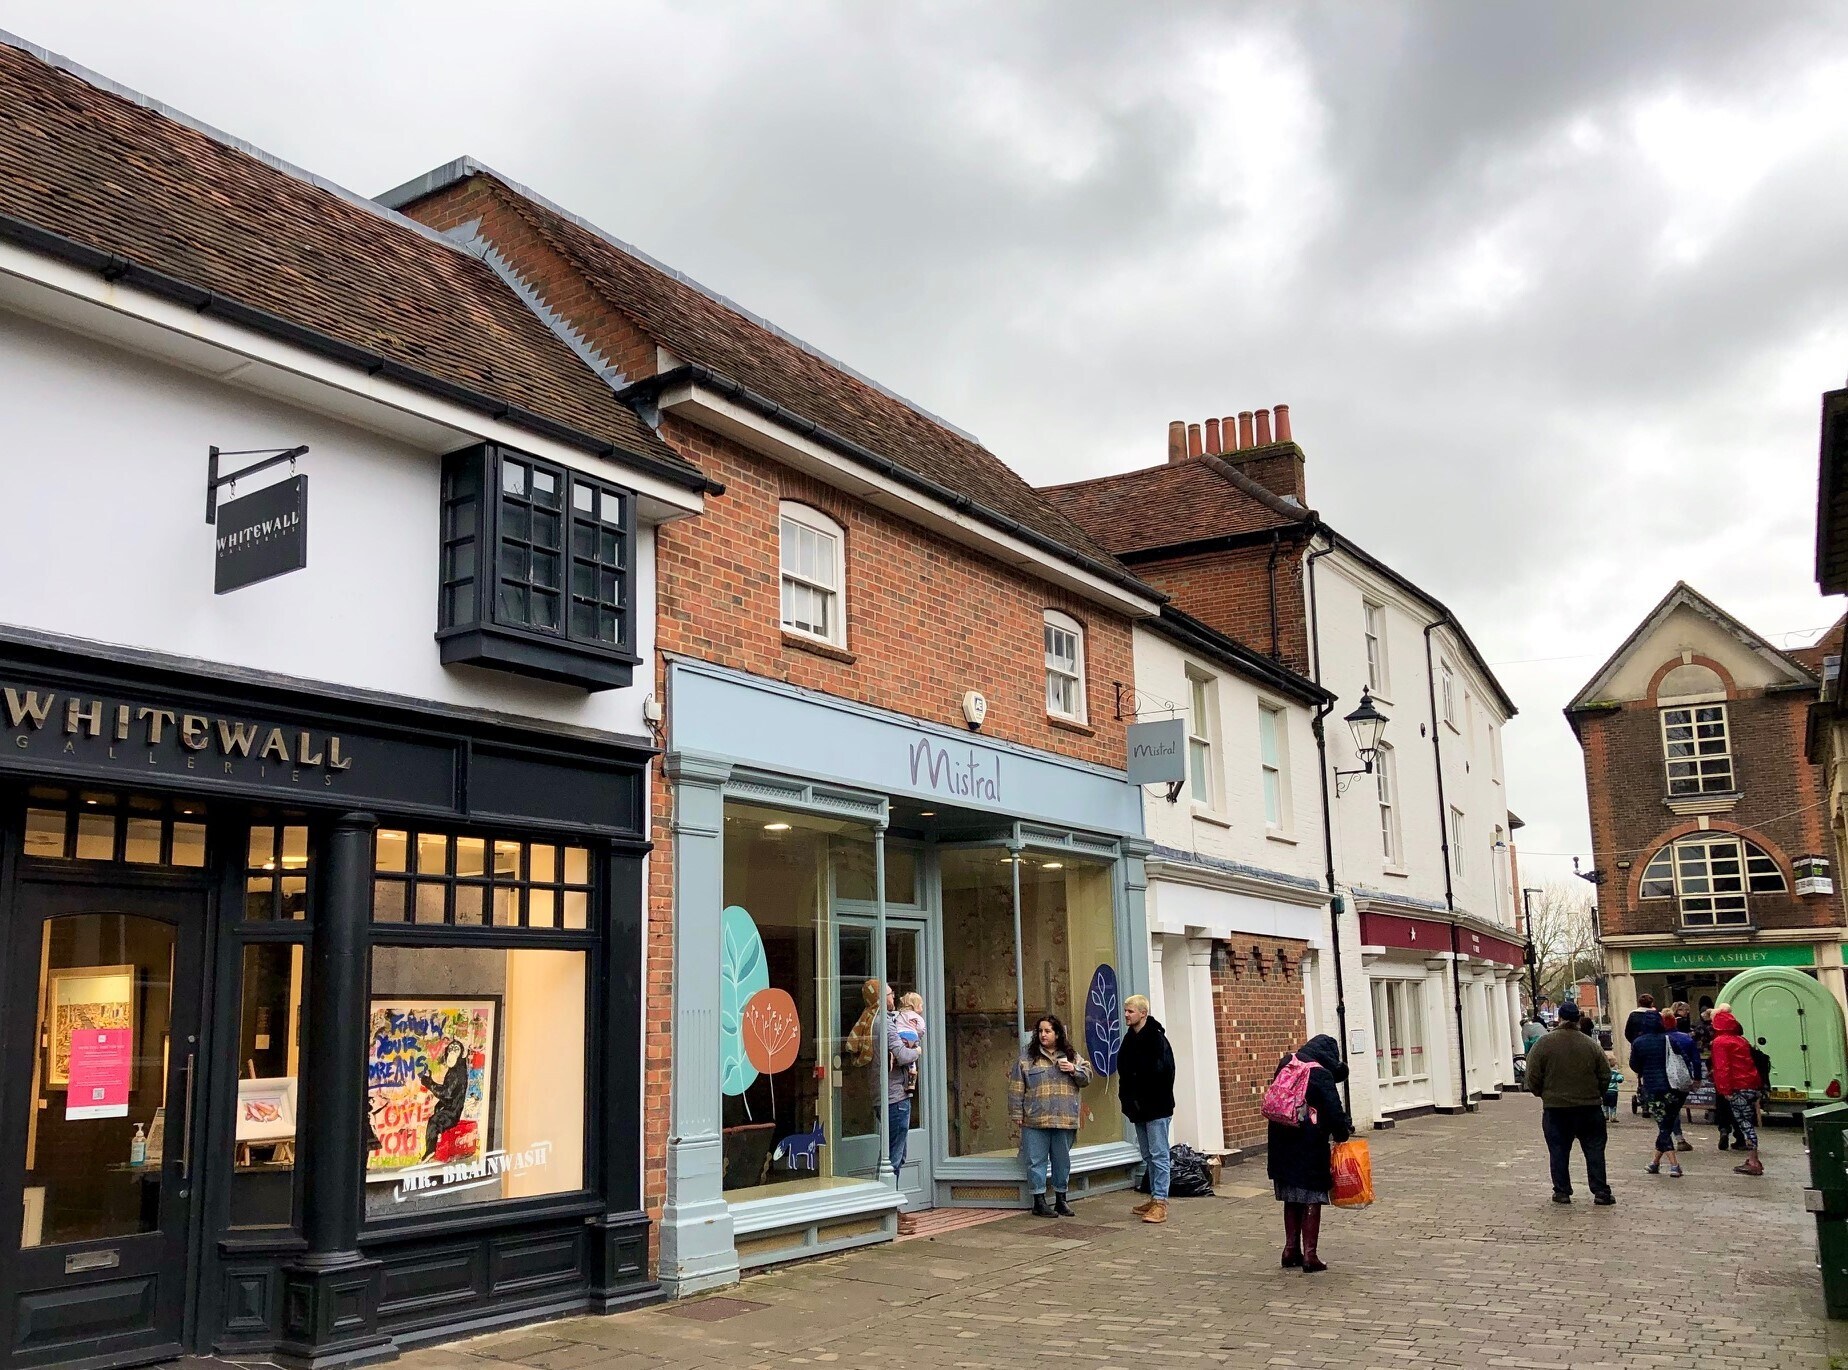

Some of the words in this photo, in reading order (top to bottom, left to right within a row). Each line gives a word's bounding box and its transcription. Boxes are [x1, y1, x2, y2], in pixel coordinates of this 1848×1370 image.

[216, 511, 299, 551] WHITEWALL
[3, 687, 352, 769] WHITEWALL
[1133, 740, 1175, 758] Mistral
[15, 734, 332, 787] GALLERIES
[909, 737, 1001, 802] Mistral
[1673, 954, 1714, 963] LAURA
[1719, 952, 1768, 962] ASHLEY
[402, 1172, 437, 1192] MR.
[443, 1148, 547, 1184] BRAINWASH
